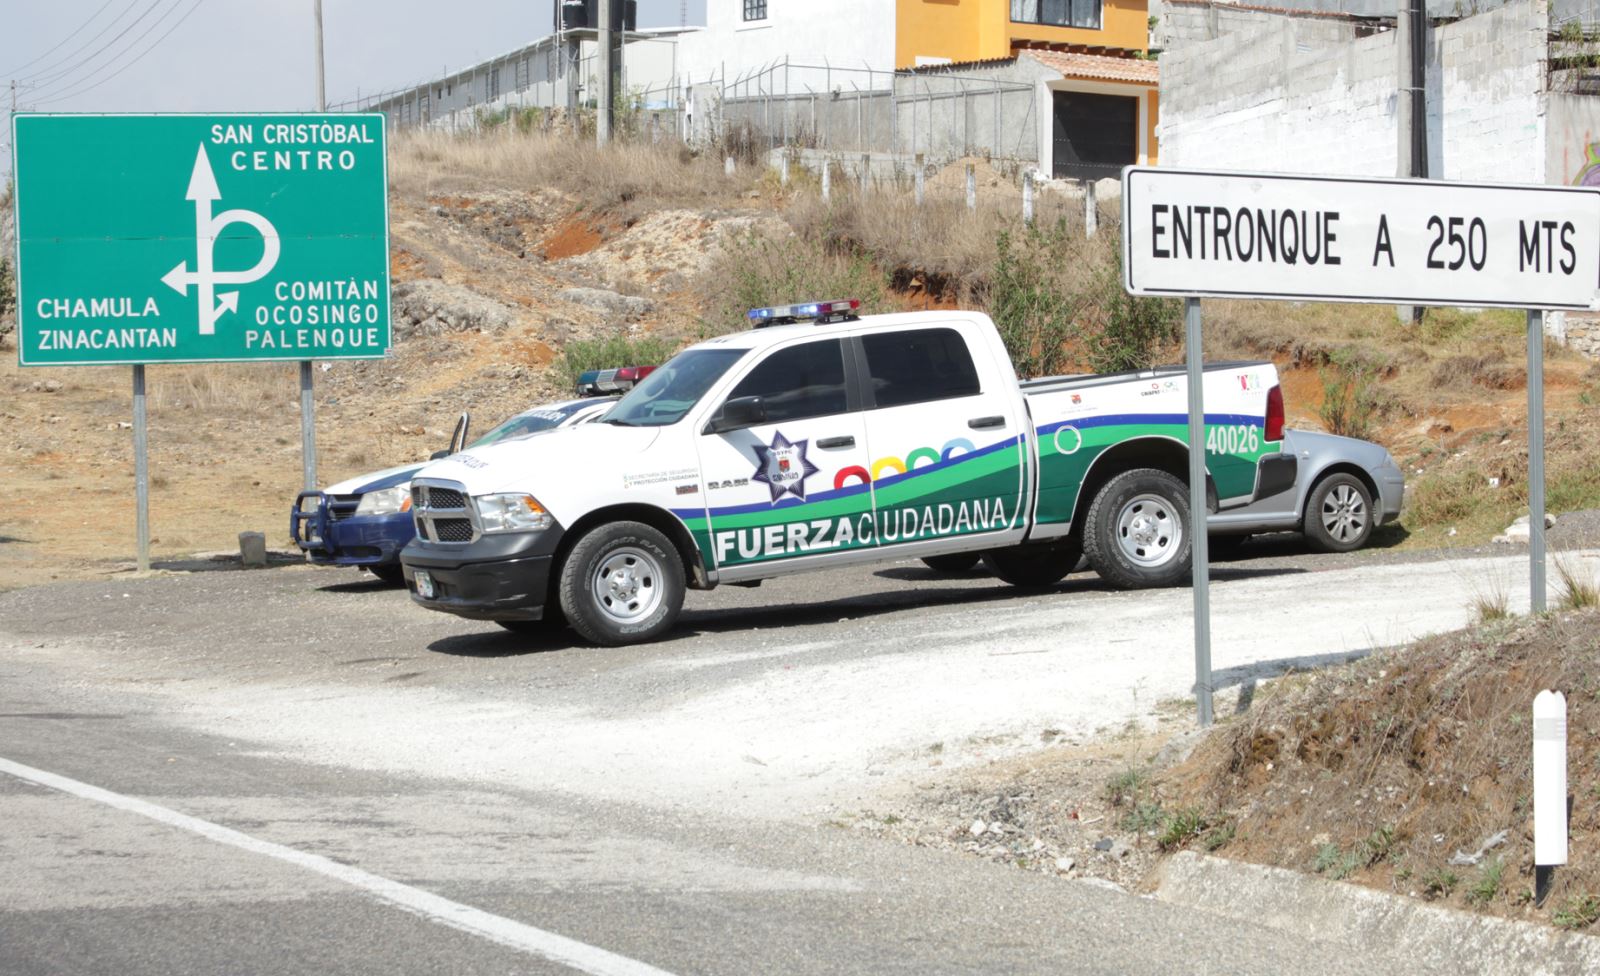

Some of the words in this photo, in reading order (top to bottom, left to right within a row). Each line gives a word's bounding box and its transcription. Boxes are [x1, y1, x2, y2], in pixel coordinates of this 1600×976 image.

[211, 124, 253, 144] SAN
[231, 151, 356, 170] CENTRO
[1151, 204, 1342, 266] ENTRONQUE
[1371, 214, 1395, 267] A
[1426, 215, 1487, 271] 250
[1519, 219, 1577, 275] MTS
[37, 297, 160, 319] CHAMULA
[255, 304, 378, 325] OCOSINGO
[38, 328, 177, 350] ZINACANTAN
[245, 328, 379, 348] PALENQUE
[1207, 424, 1259, 454] 40026
[707, 478, 749, 490] RAM
[716, 517, 854, 562] FUERZA
